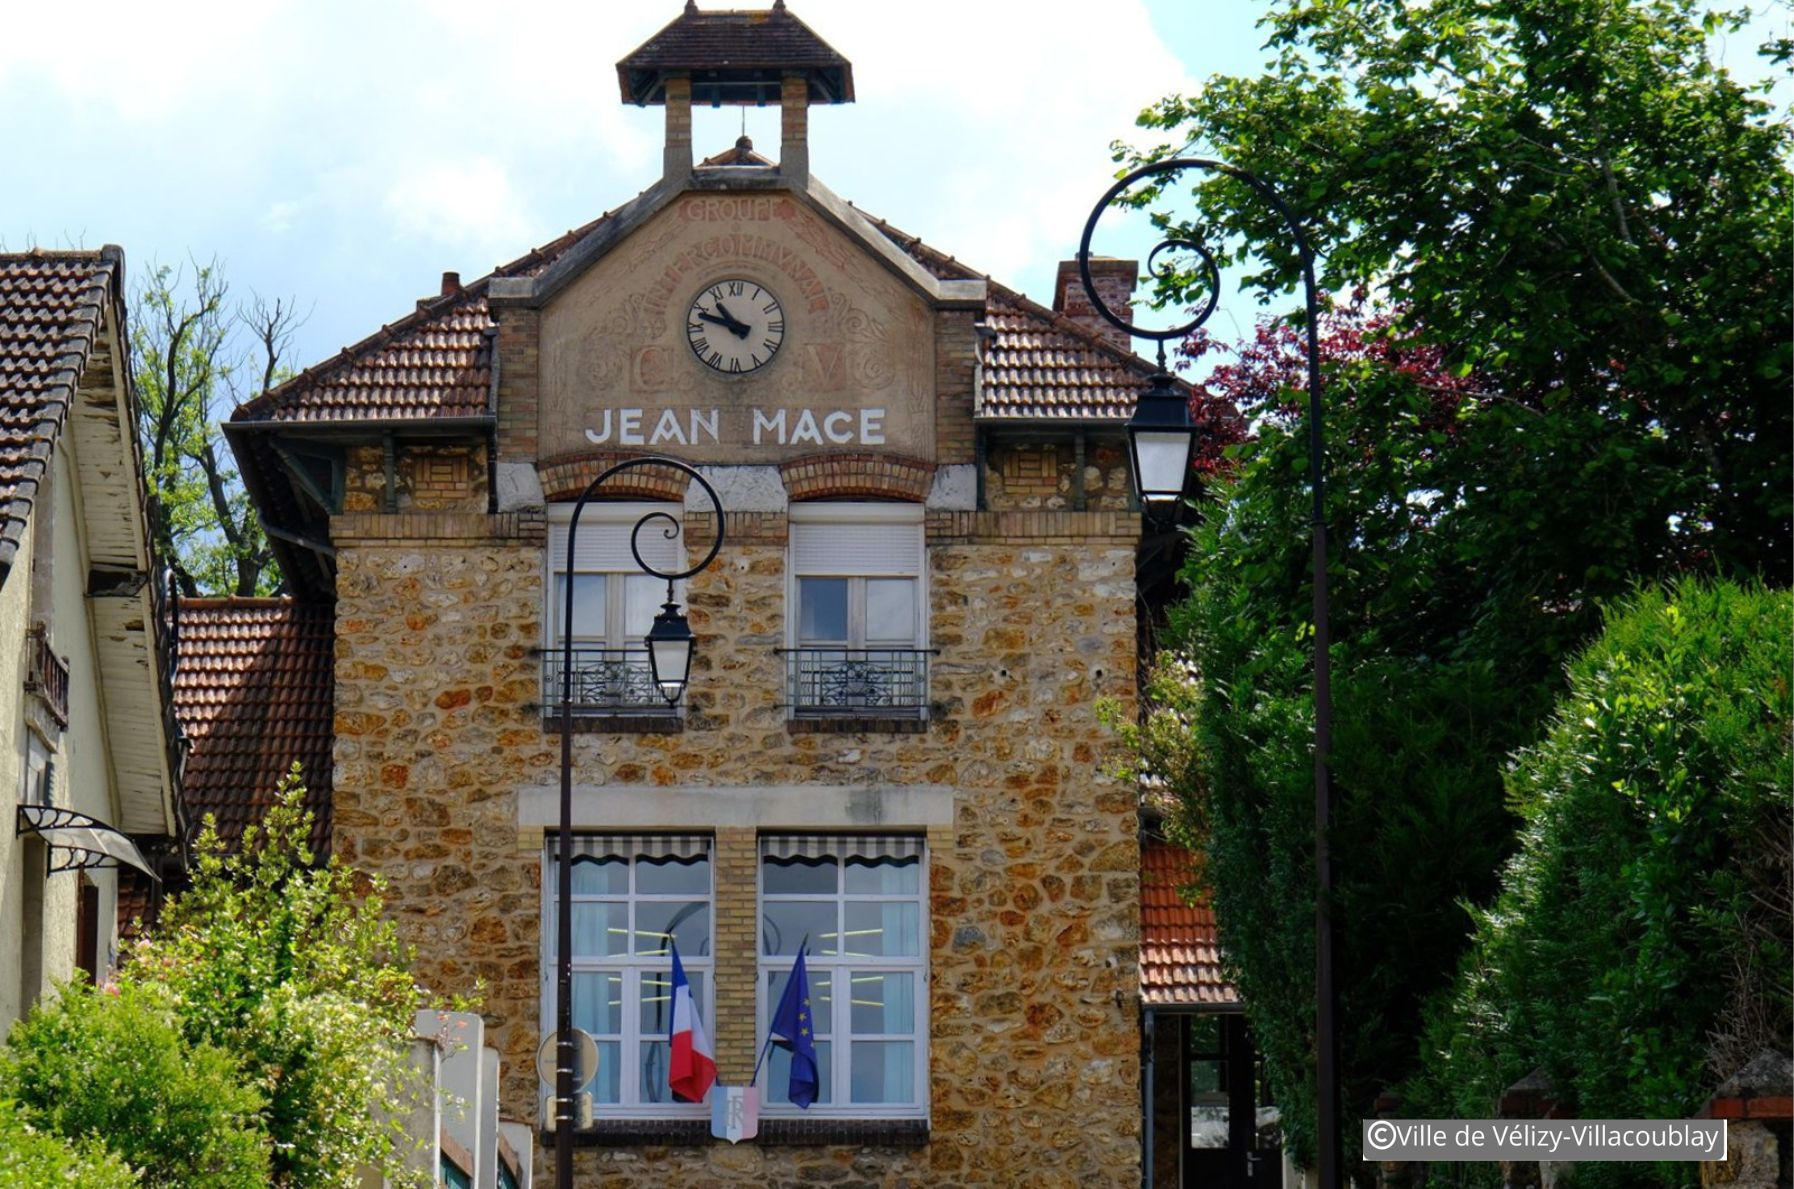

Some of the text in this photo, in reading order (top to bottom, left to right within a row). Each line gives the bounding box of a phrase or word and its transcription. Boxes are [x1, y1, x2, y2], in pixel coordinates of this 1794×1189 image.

[686, 198, 779, 222] GROUPE
[708, 286, 724, 302] XI
[728, 281, 744, 297] XII
[751, 287, 761, 301] I
[762, 301, 780, 315] II
[688, 321, 704, 334] IX
[767, 320, 783, 333] III
[585, 408, 886, 446] JEAN MACE
